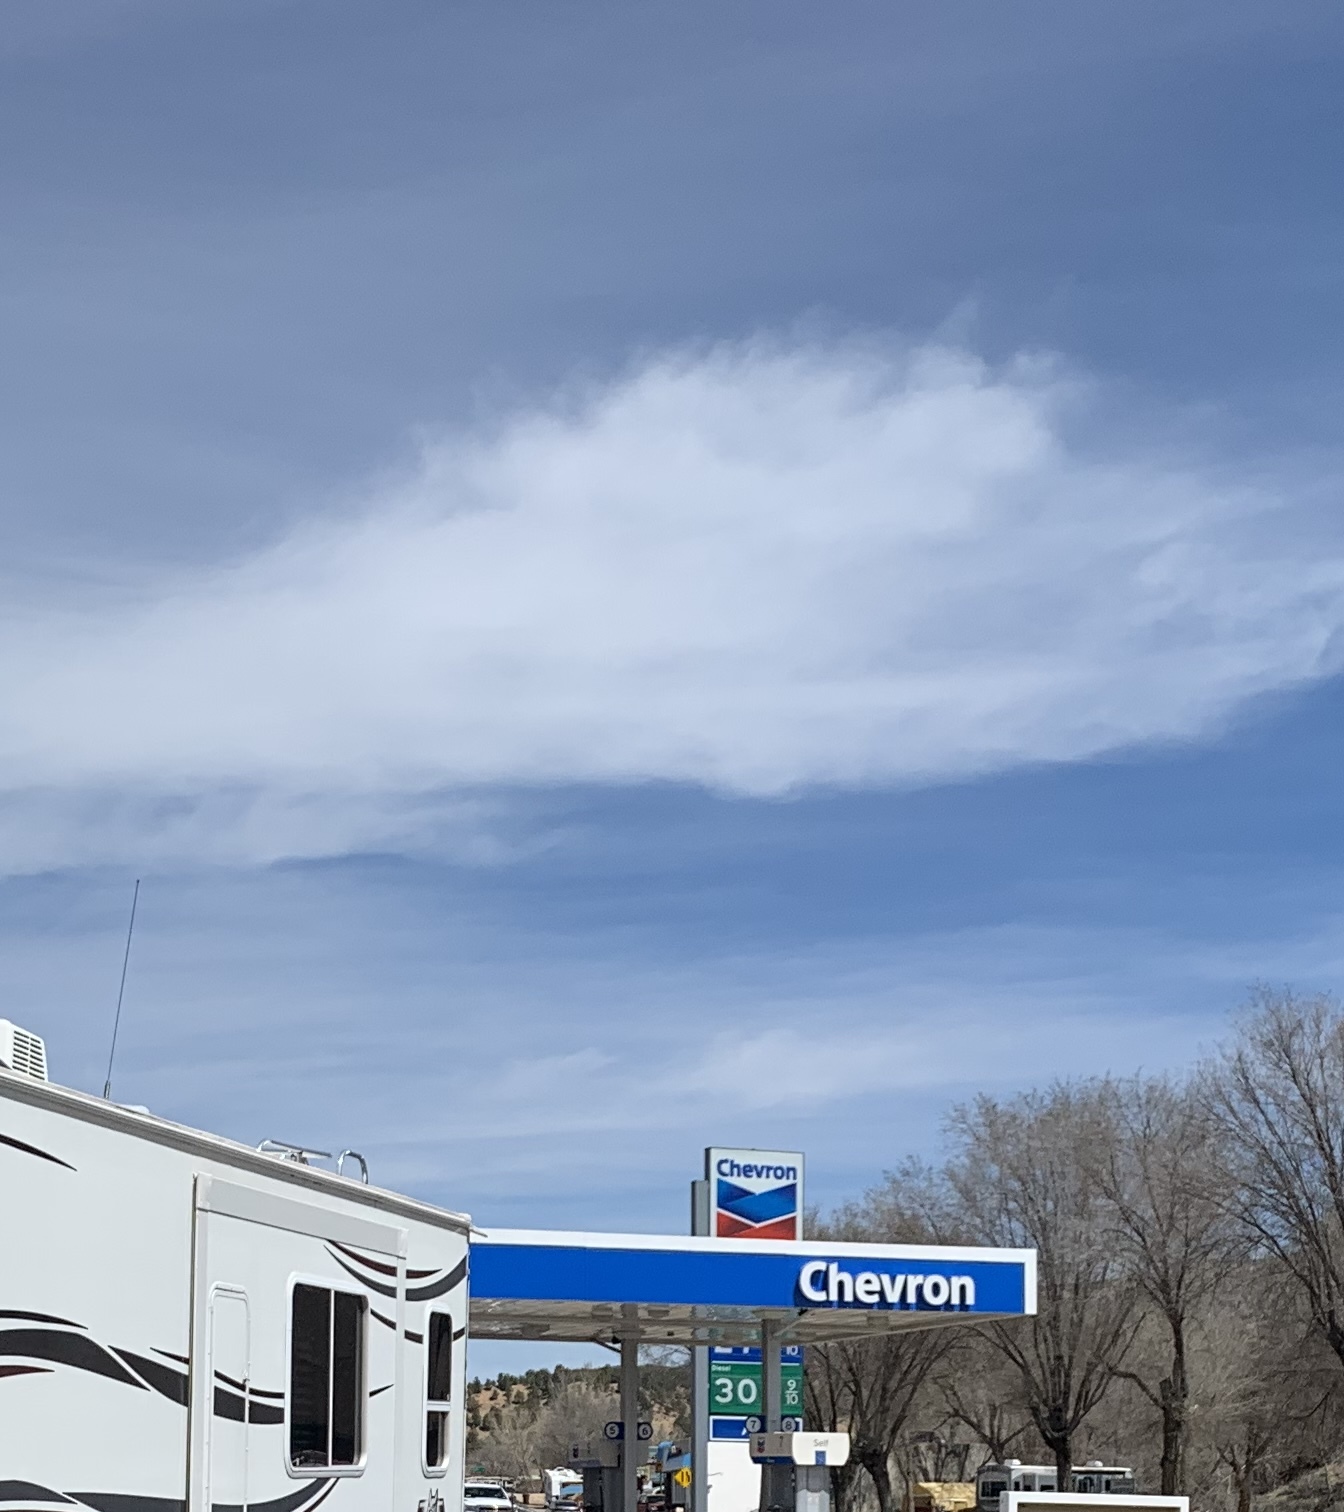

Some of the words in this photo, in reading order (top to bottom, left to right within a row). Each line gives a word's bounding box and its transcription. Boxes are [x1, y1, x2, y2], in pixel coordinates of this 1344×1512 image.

[716, 1158, 797, 1181] Chevron
[799, 1260, 976, 1306] Chevron
[711, 1364, 732, 1372] Diesel
[714, 1377, 757, 1404] 30
[813, 1438, 829, 1447] Self
